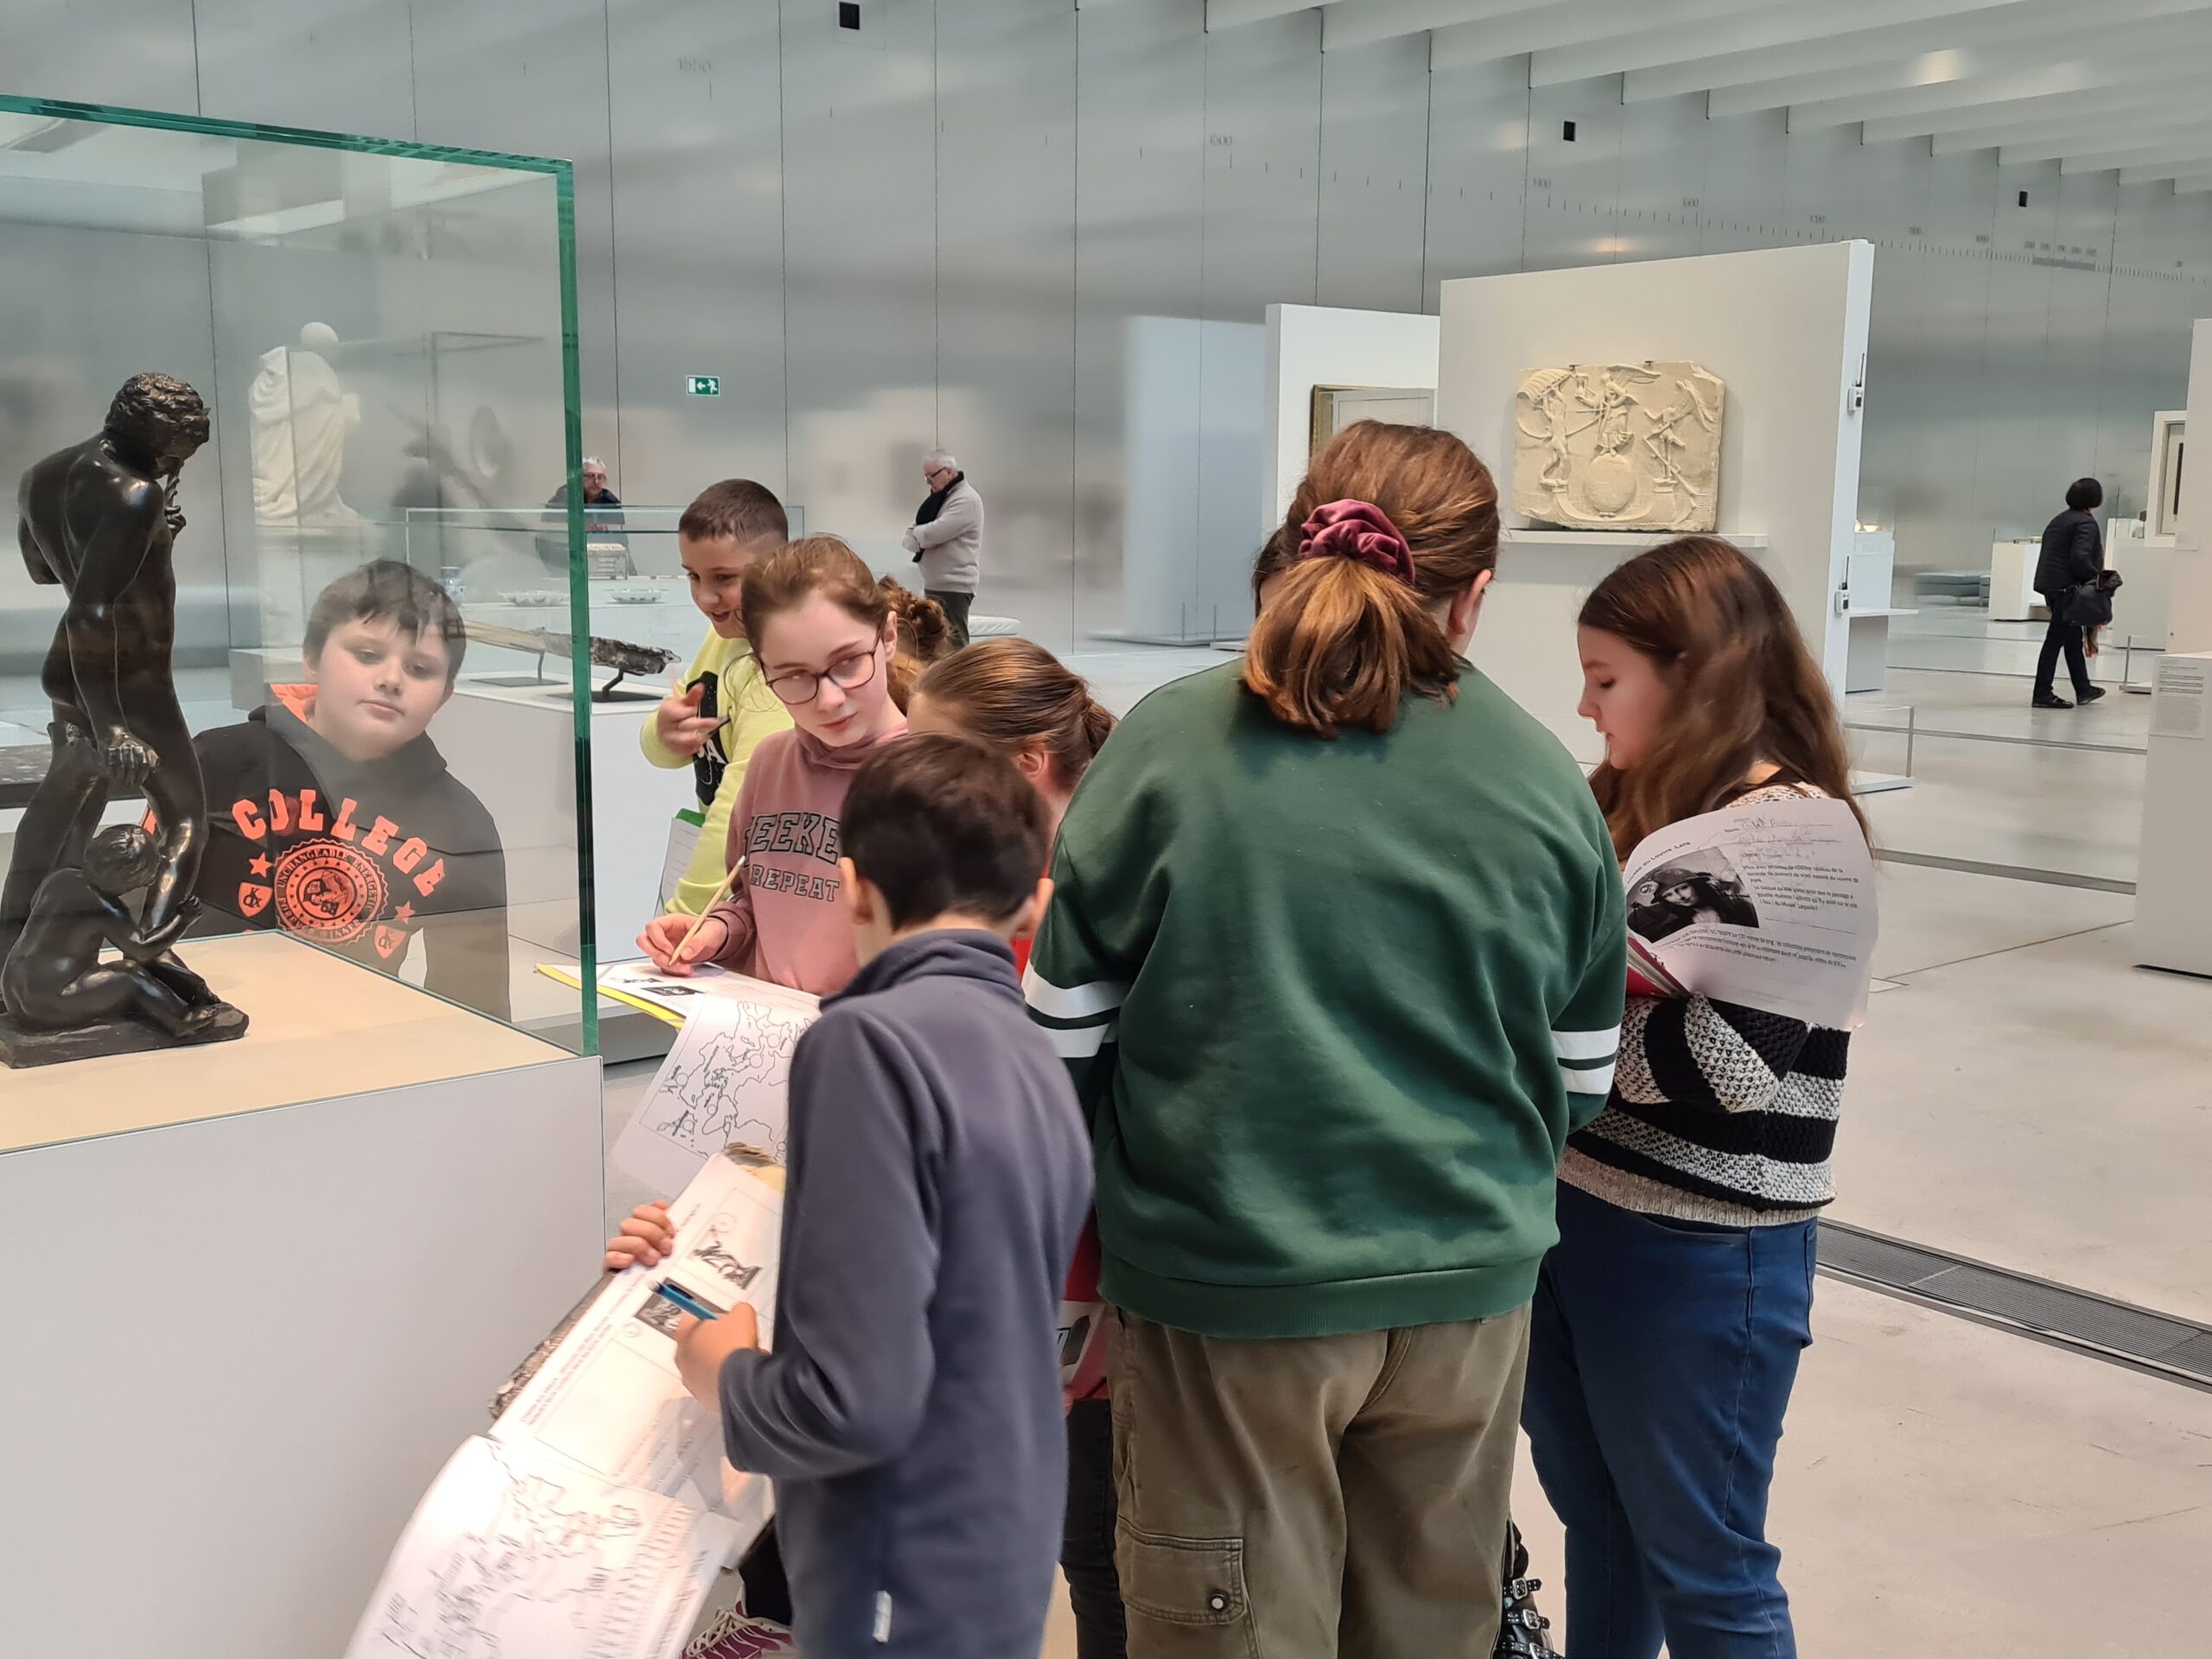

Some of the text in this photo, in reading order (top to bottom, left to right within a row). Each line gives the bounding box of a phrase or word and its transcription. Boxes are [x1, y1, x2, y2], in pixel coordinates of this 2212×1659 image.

[232, 789, 445, 897] COLLEGE
[743, 812, 840, 868] EEKE
[277, 849, 347, 887] UNCHANGEABLE
[750, 864, 840, 902] REPEAT
